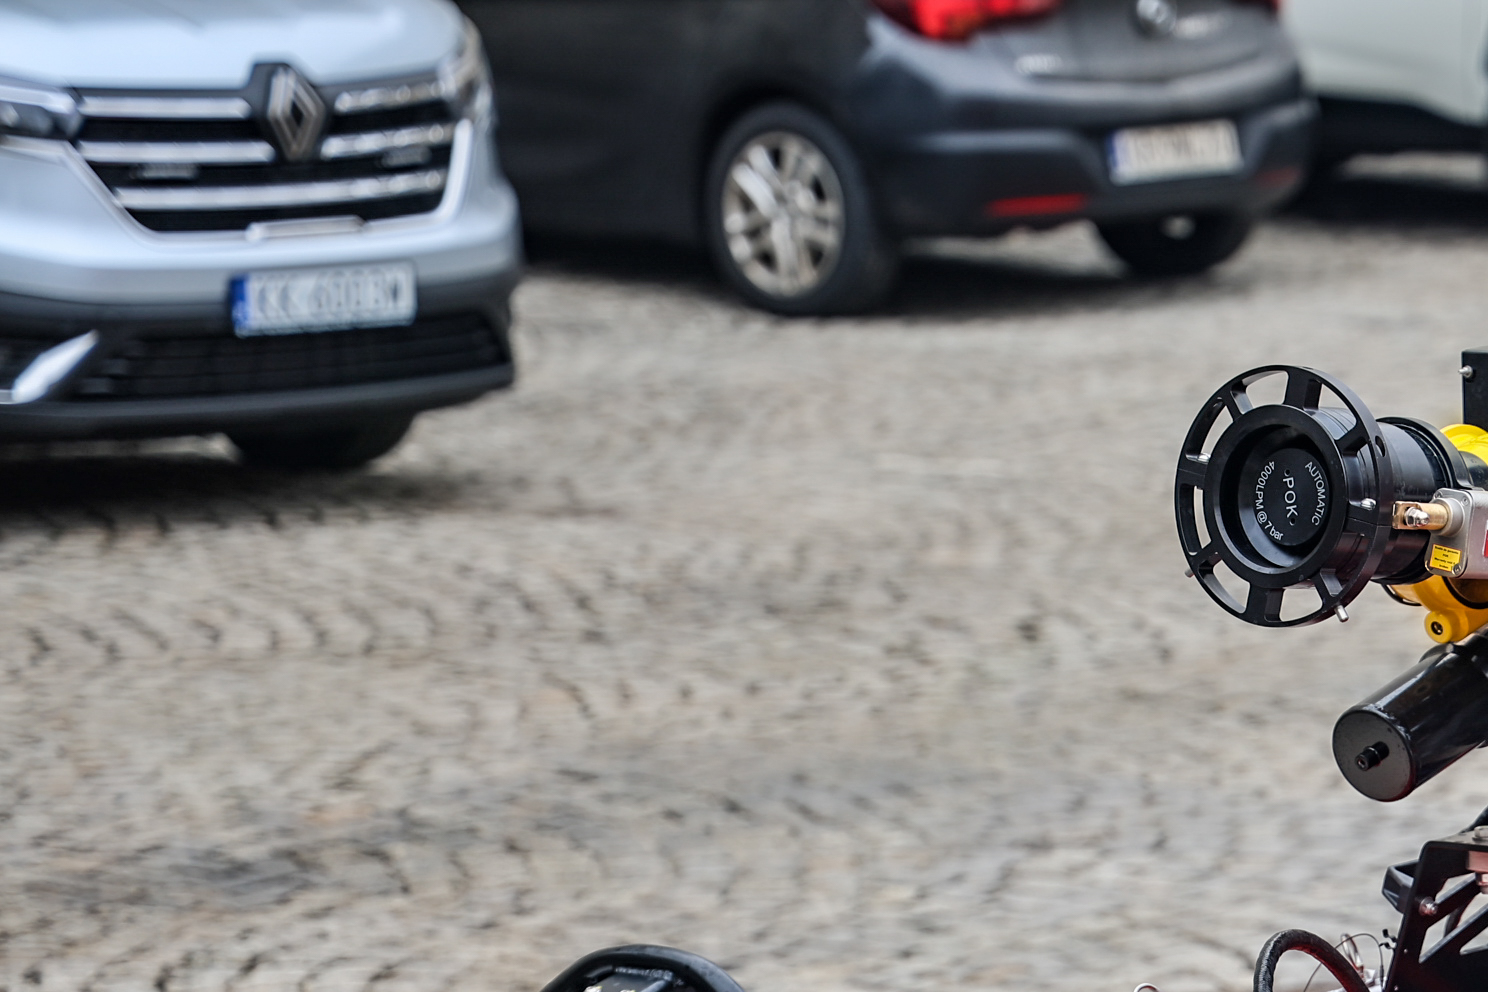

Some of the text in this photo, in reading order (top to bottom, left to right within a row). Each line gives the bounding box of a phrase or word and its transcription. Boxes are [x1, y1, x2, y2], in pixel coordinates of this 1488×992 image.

[1255, 461, 1284, 541] 4000LPM @ 7 bar
[1282, 477, 1299, 518] POK
[1304, 461, 1326, 526] AUTOMATIC
